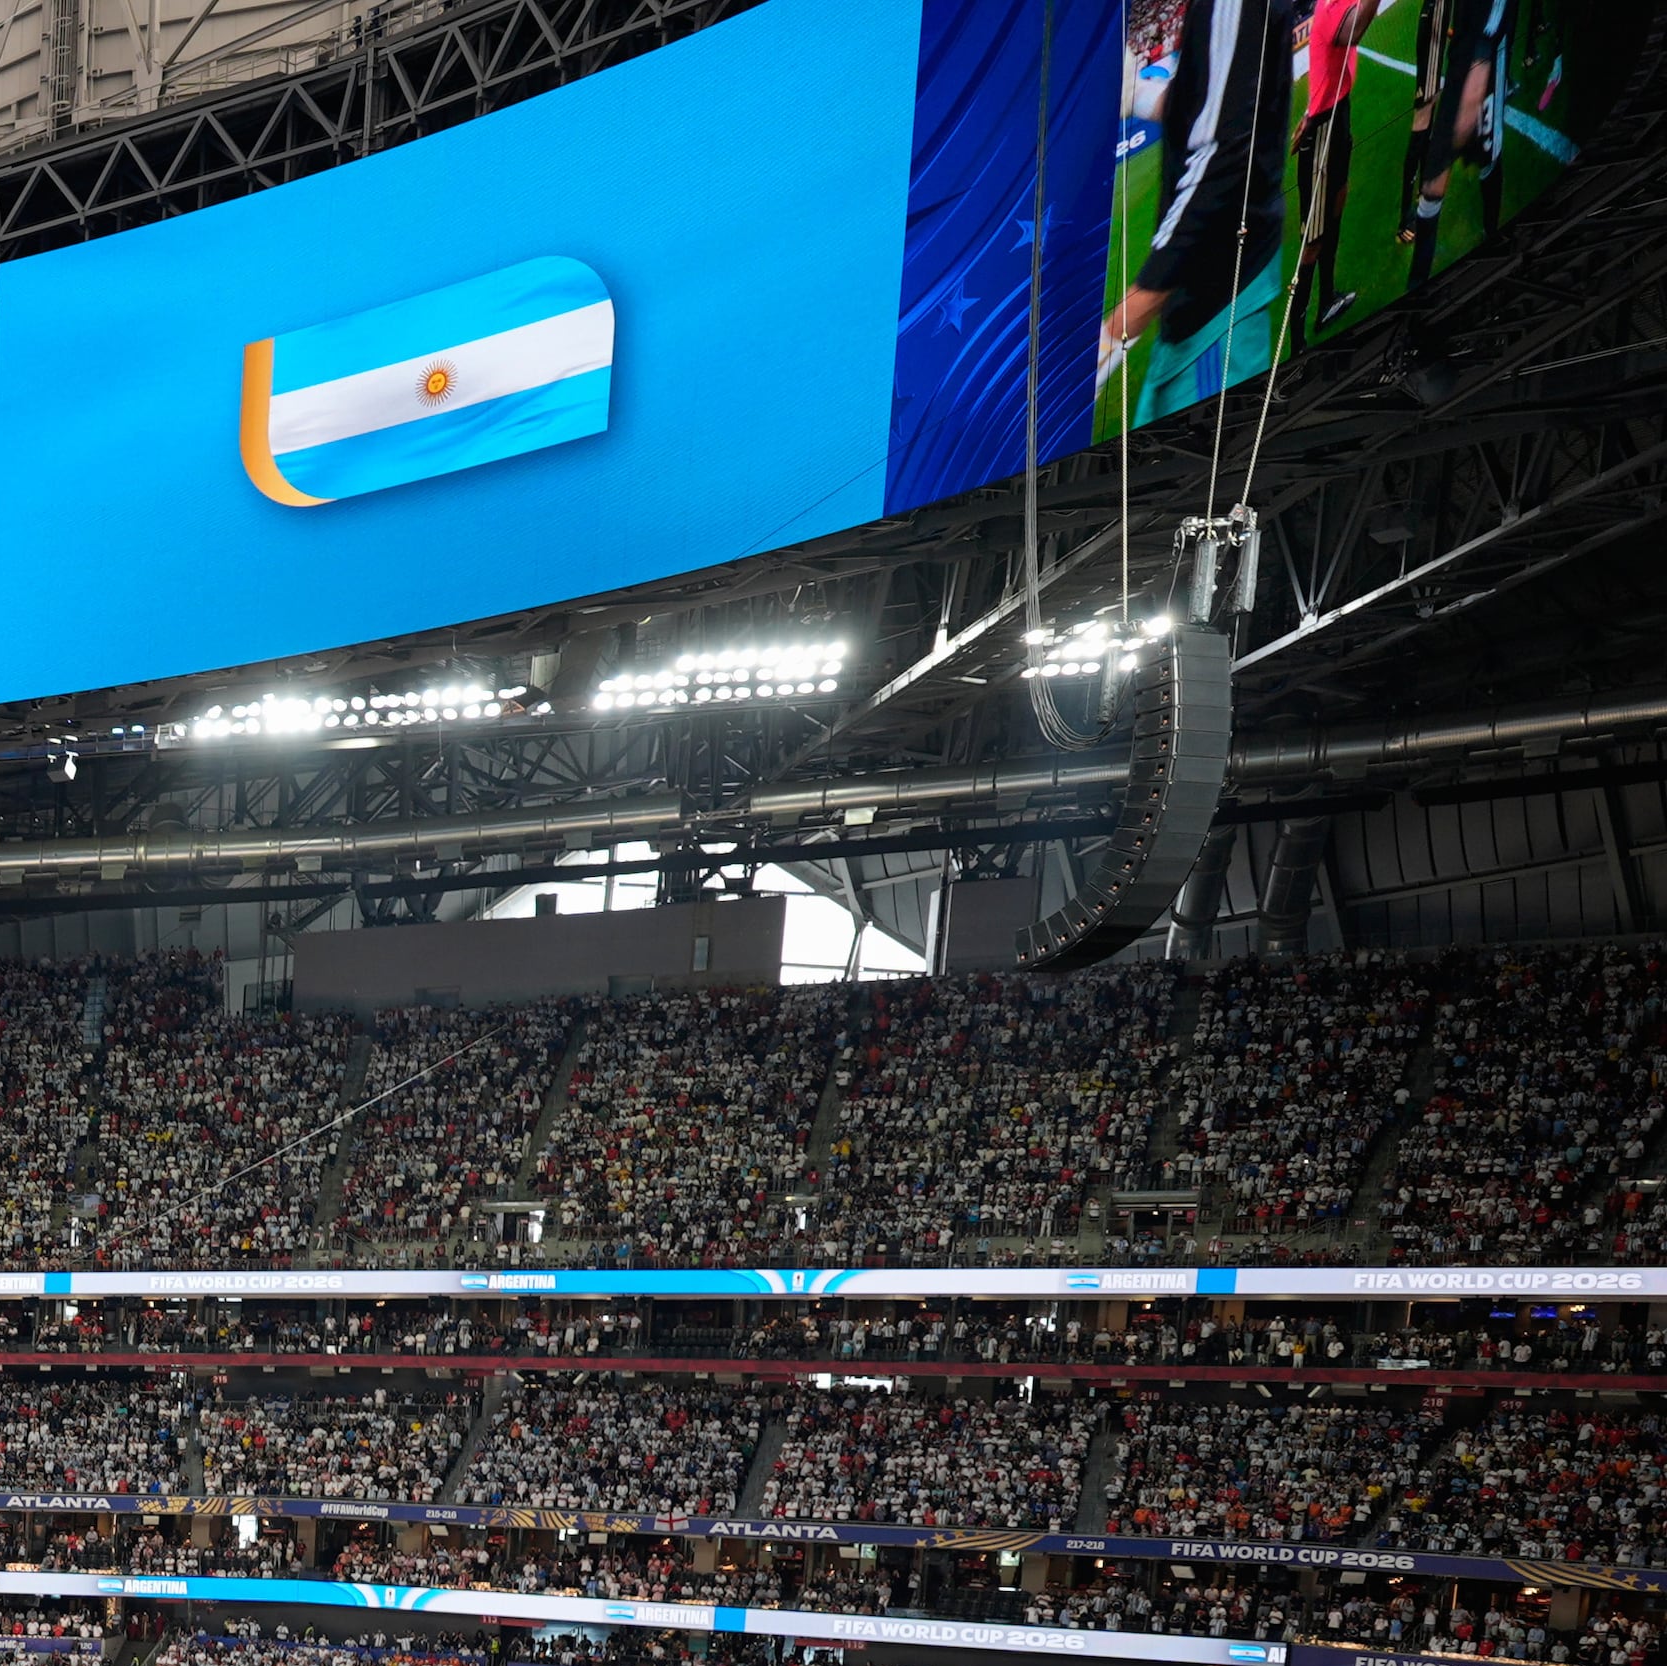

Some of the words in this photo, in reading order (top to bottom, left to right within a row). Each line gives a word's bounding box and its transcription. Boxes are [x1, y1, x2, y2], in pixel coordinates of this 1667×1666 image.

[150, 1276, 183, 1288] FIFA
[185, 1276, 246, 1288] WORLD
[248, 1276, 281, 1288] CUP
[283, 1276, 343, 1288] 2026
[489, 1274, 556, 1288] ARGENTINA
[1101, 1274, 1186, 1288] ARGENTINA
[1353, 1273, 1403, 1287] FIFA
[1405, 1273, 1495, 1288] WORLD
[1497, 1274, 1548, 1289] CUP
[1551, 1274, 1643, 1289] 2026
[6, 1496, 111, 1509] ATLANTA
[320, 1504, 388, 1518] #FIFAWorldCup
[709, 1522, 839, 1540] ATLANTA
[1066, 1539, 1105, 1551] 217-218
[1171, 1543, 1216, 1558] FIFA
[1217, 1545, 1294, 1561] WORLD
[1297, 1548, 1339, 1564] CUP
[1341, 1551, 1415, 1570] 2026
[123, 1579, 188, 1595] ARGENTINA
[635, 1606, 710, 1625] ARGENTINA
[833, 1619, 878, 1638] FIFA
[880, 1624, 957, 1642] WORLD
[960, 1627, 1004, 1645] CUP
[1007, 1632, 1085, 1650] 2026
